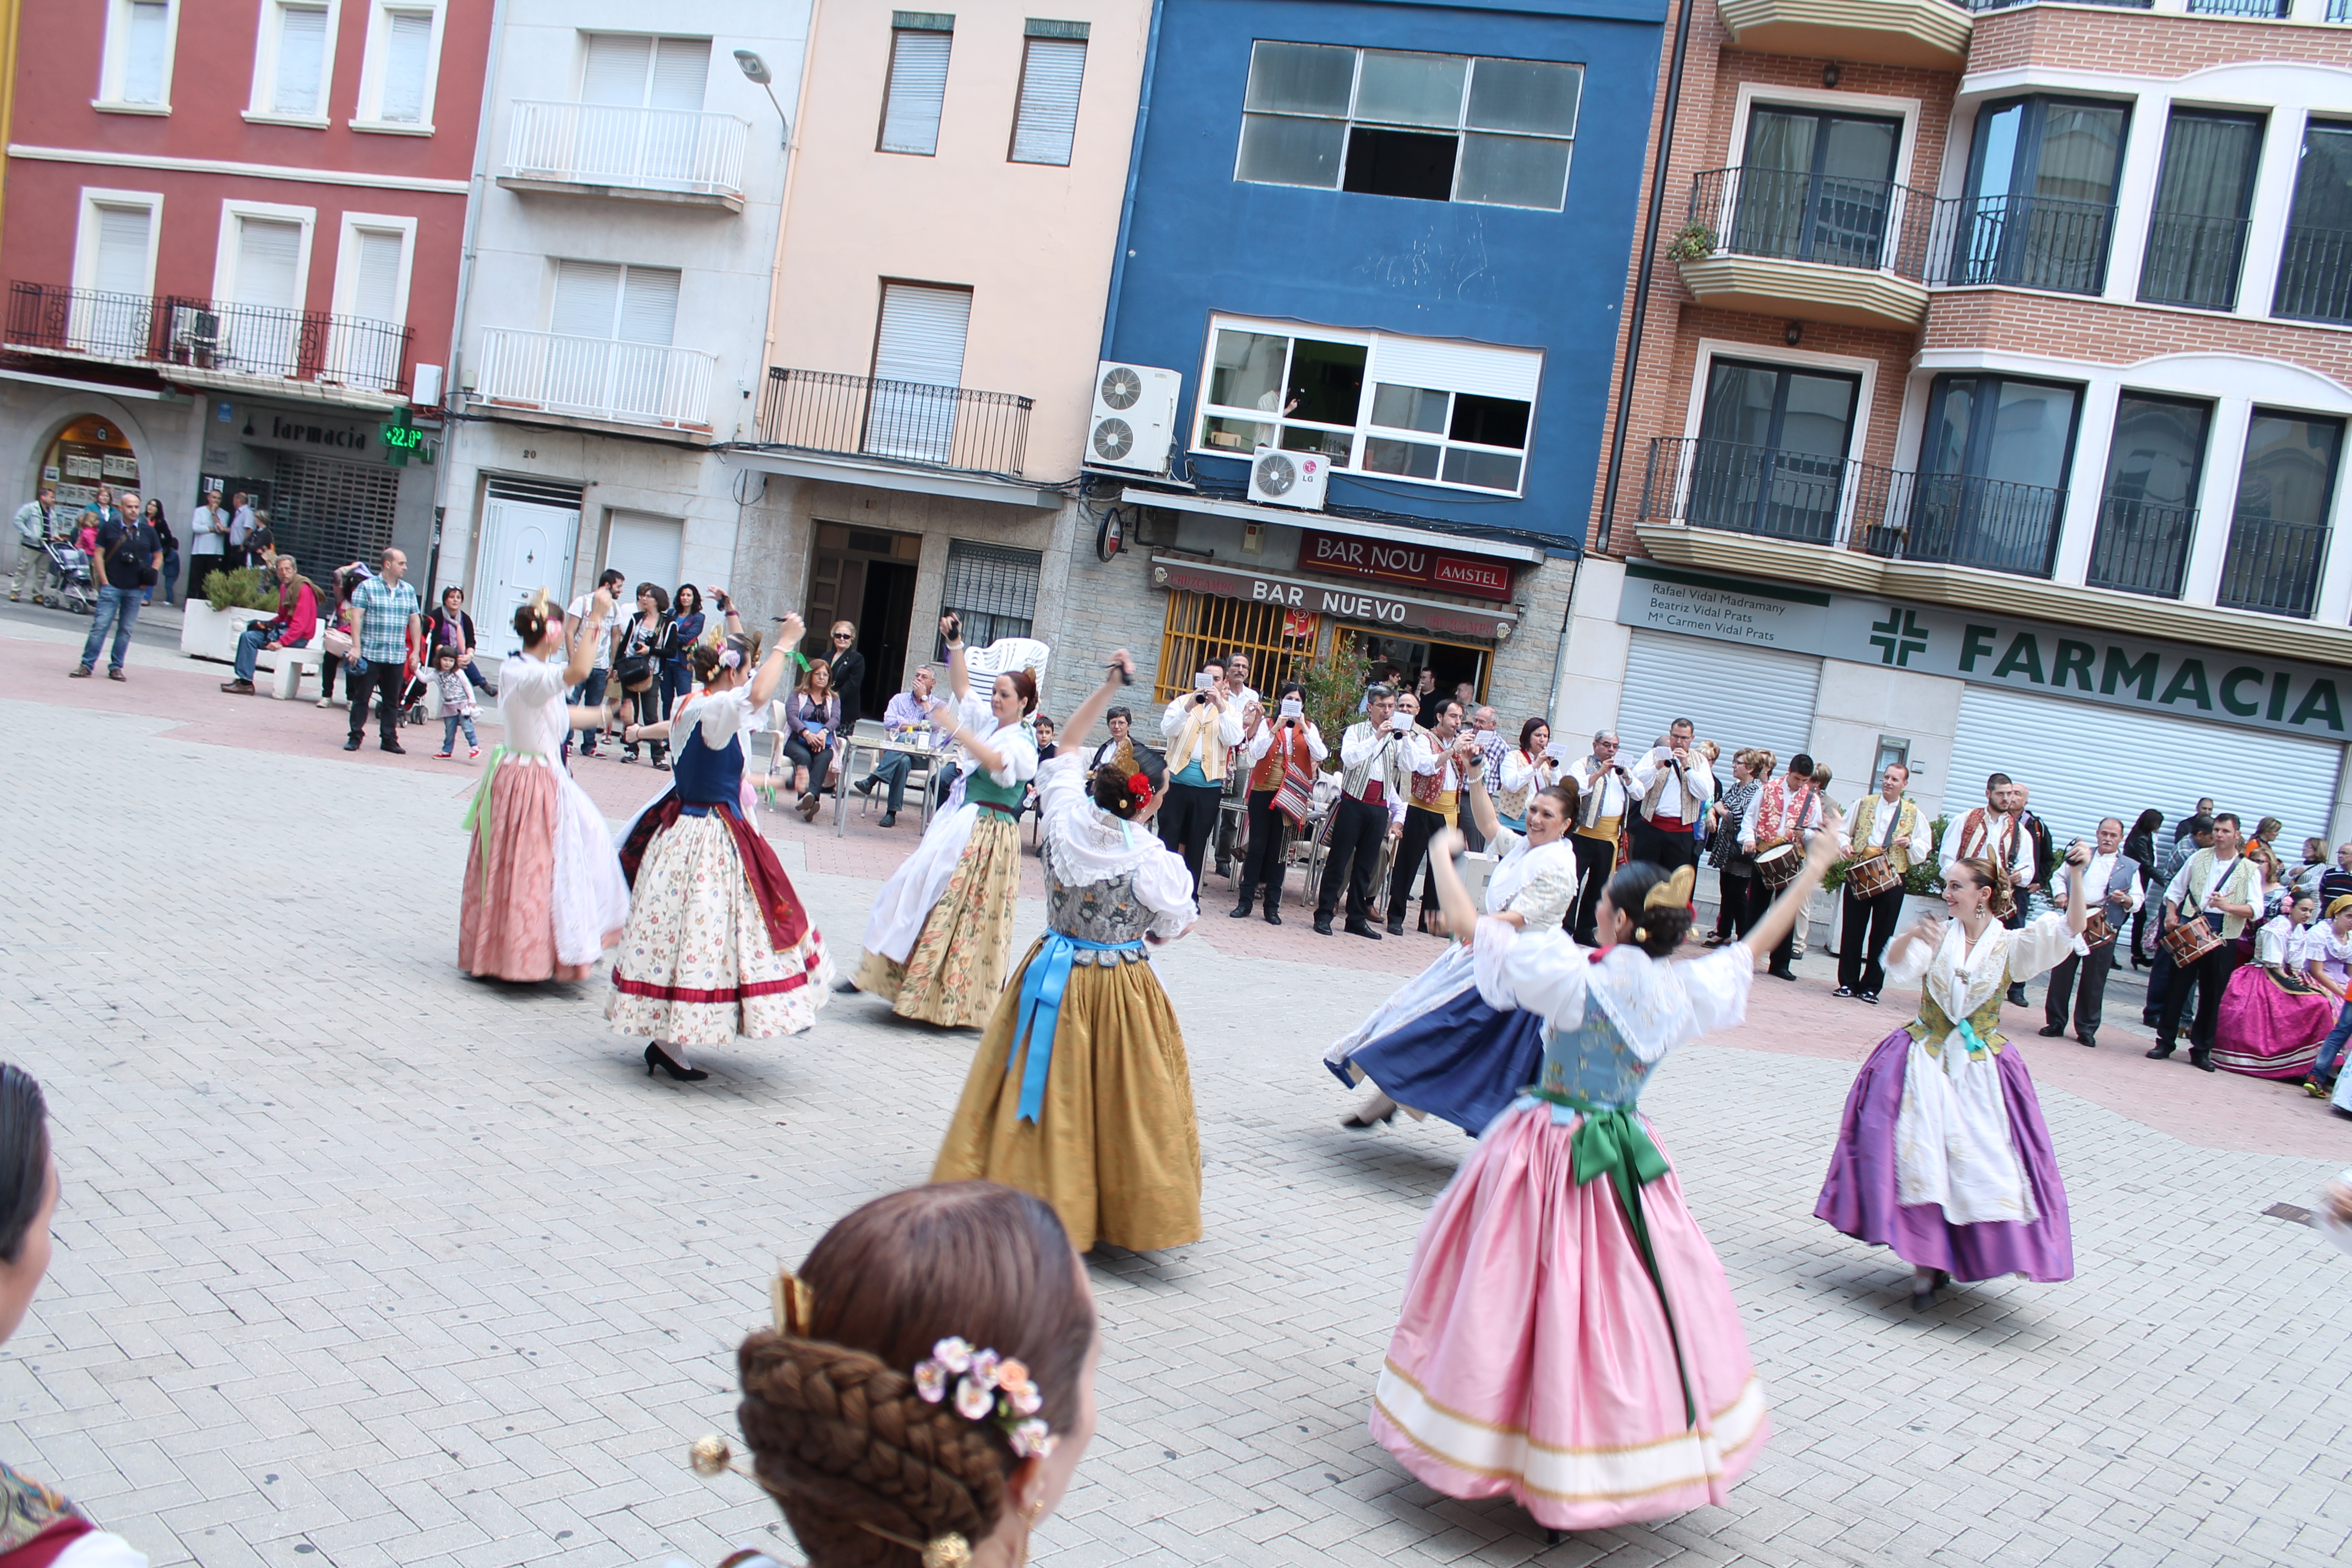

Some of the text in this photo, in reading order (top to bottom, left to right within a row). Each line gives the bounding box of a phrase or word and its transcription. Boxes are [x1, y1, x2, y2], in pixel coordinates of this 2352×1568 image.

[273, 416, 366, 450] farmacia
[523, 449, 536, 459] 20
[1316, 538, 1425, 573] BAR NOU
[1170, 574, 1235, 594] CRUZCAMPO
[1441, 565, 1498, 585] AMSTEL
[1253, 580, 1406, 623] BAR NUEVO
[1650, 598, 1752, 623] Beatriz Vidal Prats
[1652, 584, 1785, 616] Rafael Vidal Madramany
[1425, 614, 1493, 635] CRUZCAMPO
[1667, 614, 1711, 630] Carmen
[1715, 622, 1743, 636] Vidal
[1746, 627, 1774, 641] Prats
[1958, 623, 2345, 732] FARMACIA
